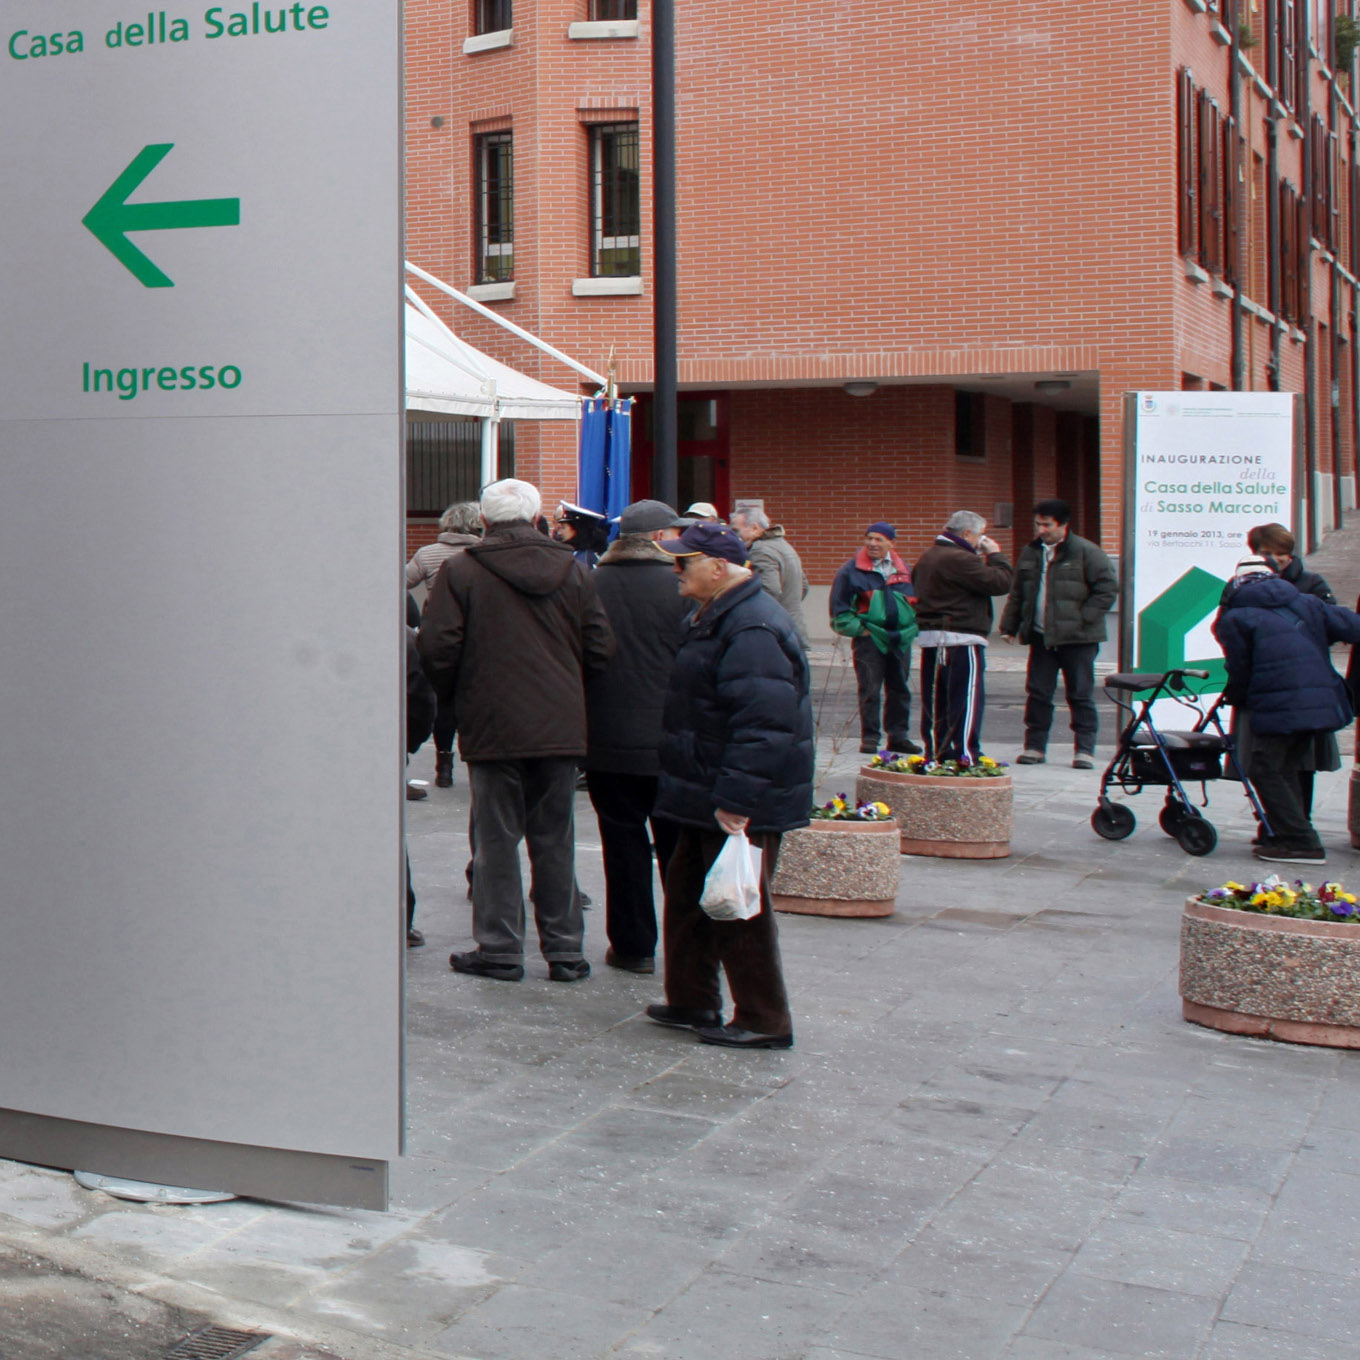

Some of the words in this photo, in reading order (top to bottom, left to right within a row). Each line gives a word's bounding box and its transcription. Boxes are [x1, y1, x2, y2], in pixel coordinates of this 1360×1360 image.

[8, 29, 84, 60] Casa
[105, 11, 189, 49] della
[204, 1, 330, 39] Salute
[82, 361, 242, 400] Ingresso
[1141, 454, 1262, 465] INAUGURAZIONE
[1239, 467, 1276, 480] della
[1144, 480, 1187, 494] Casa
[1190, 481, 1232, 494] della
[1235, 481, 1287, 495] Salute
[1140, 501, 1153, 513] di
[1157, 500, 1203, 513] Sasso
[1208, 500, 1278, 514] Marconi
[1147, 530, 1158, 538] 19
[1160, 530, 1198, 539] gennaio
